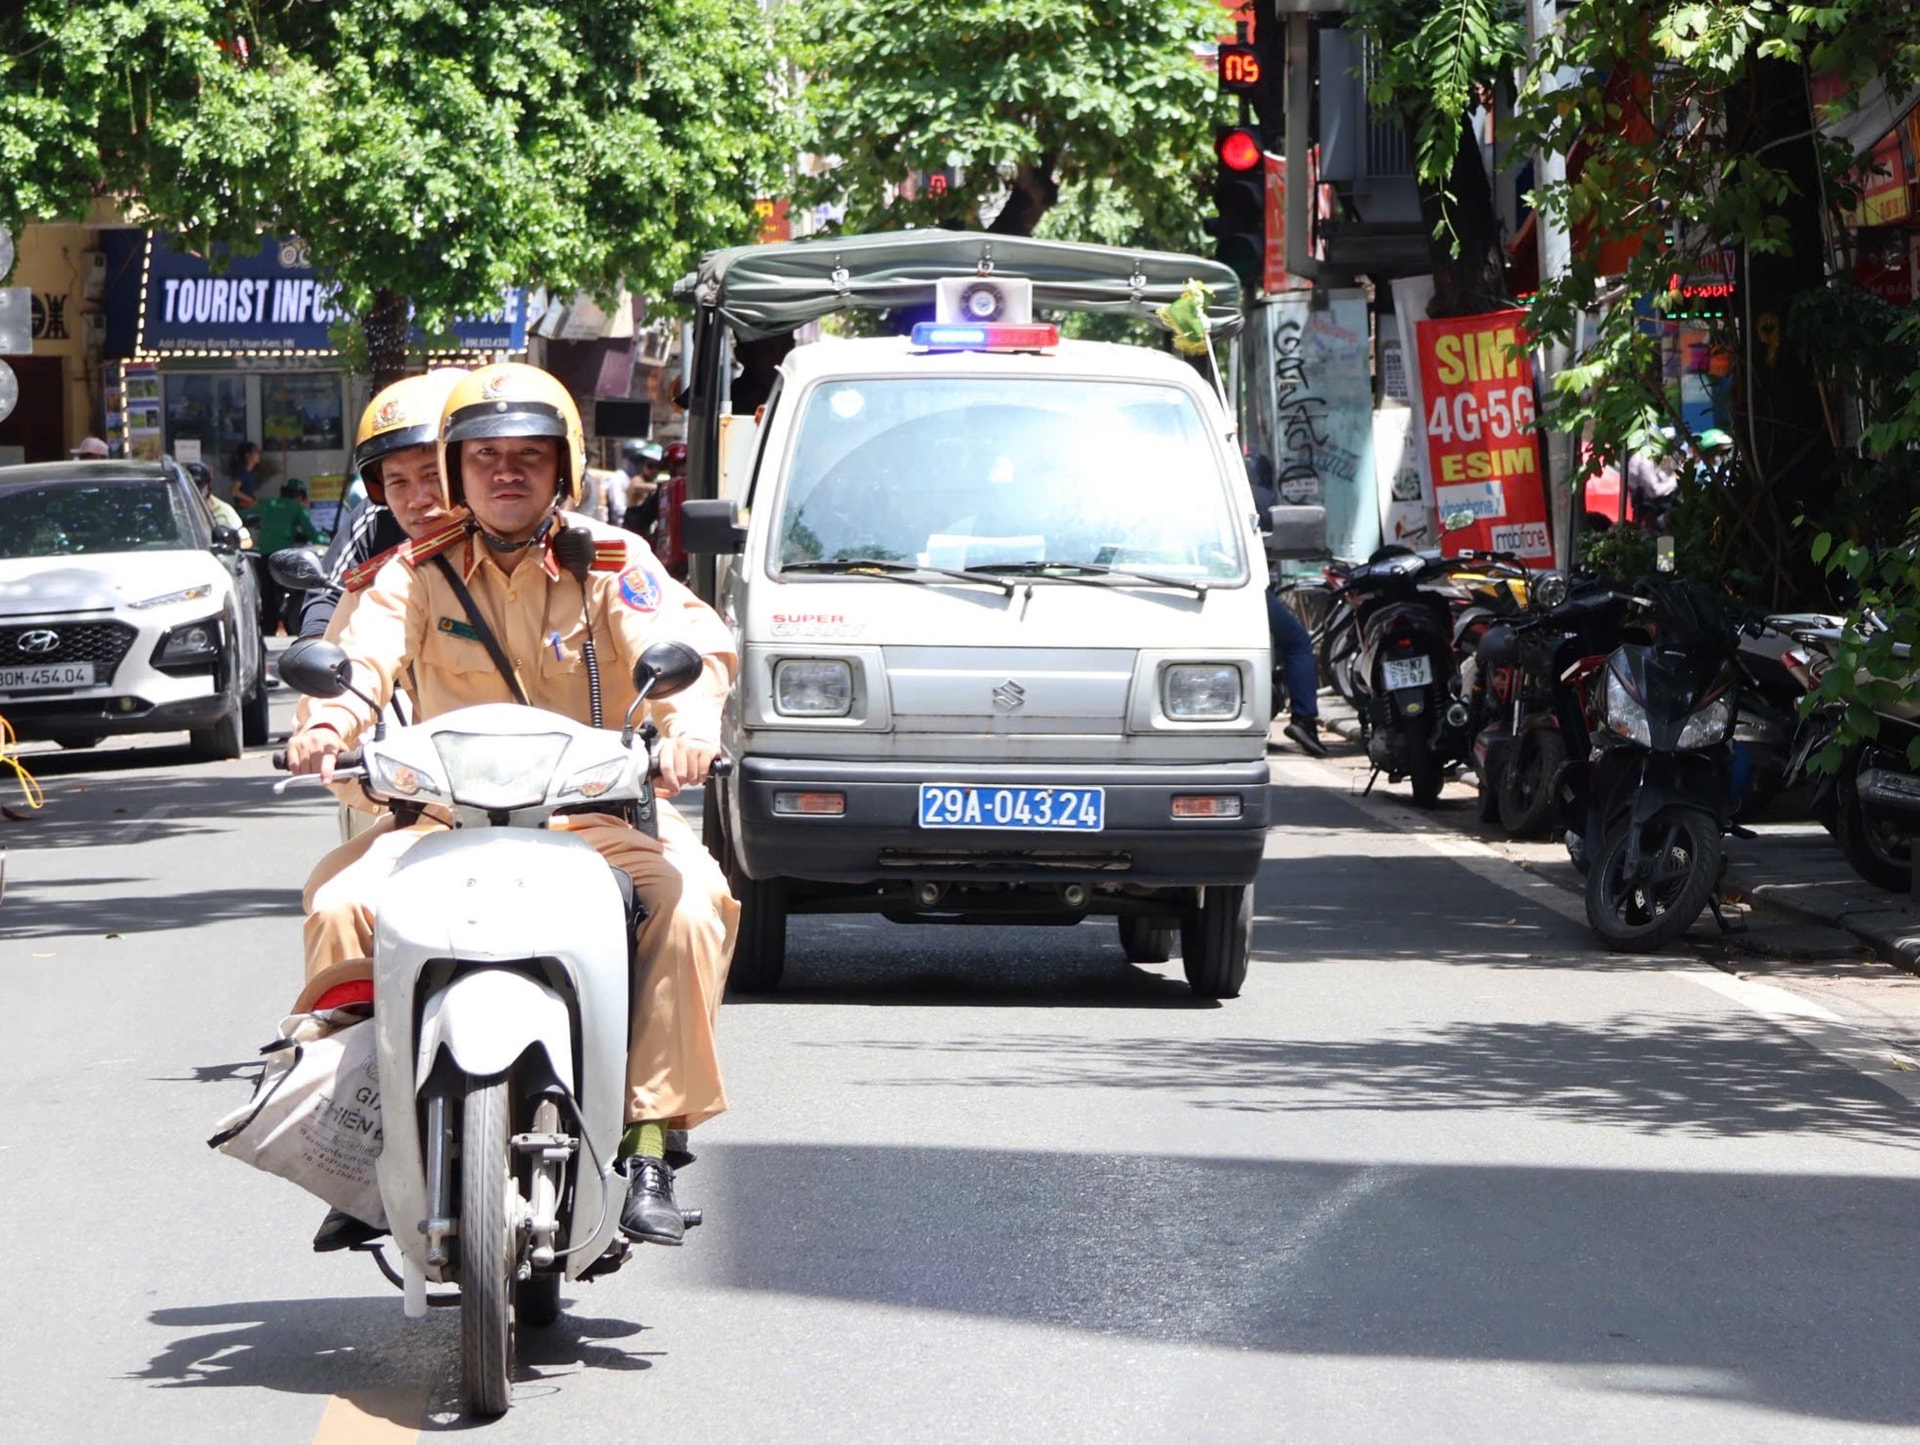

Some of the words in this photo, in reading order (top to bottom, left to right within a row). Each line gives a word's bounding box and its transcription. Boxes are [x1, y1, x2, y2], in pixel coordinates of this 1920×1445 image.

[165, 278, 269, 324] TOURIST
[1435, 329, 1518, 386] SIM
[1441, 447, 1535, 482] ESIM
[772, 614, 844, 623] SUPER
[925, 788, 1097, 826] 29A-043.24
